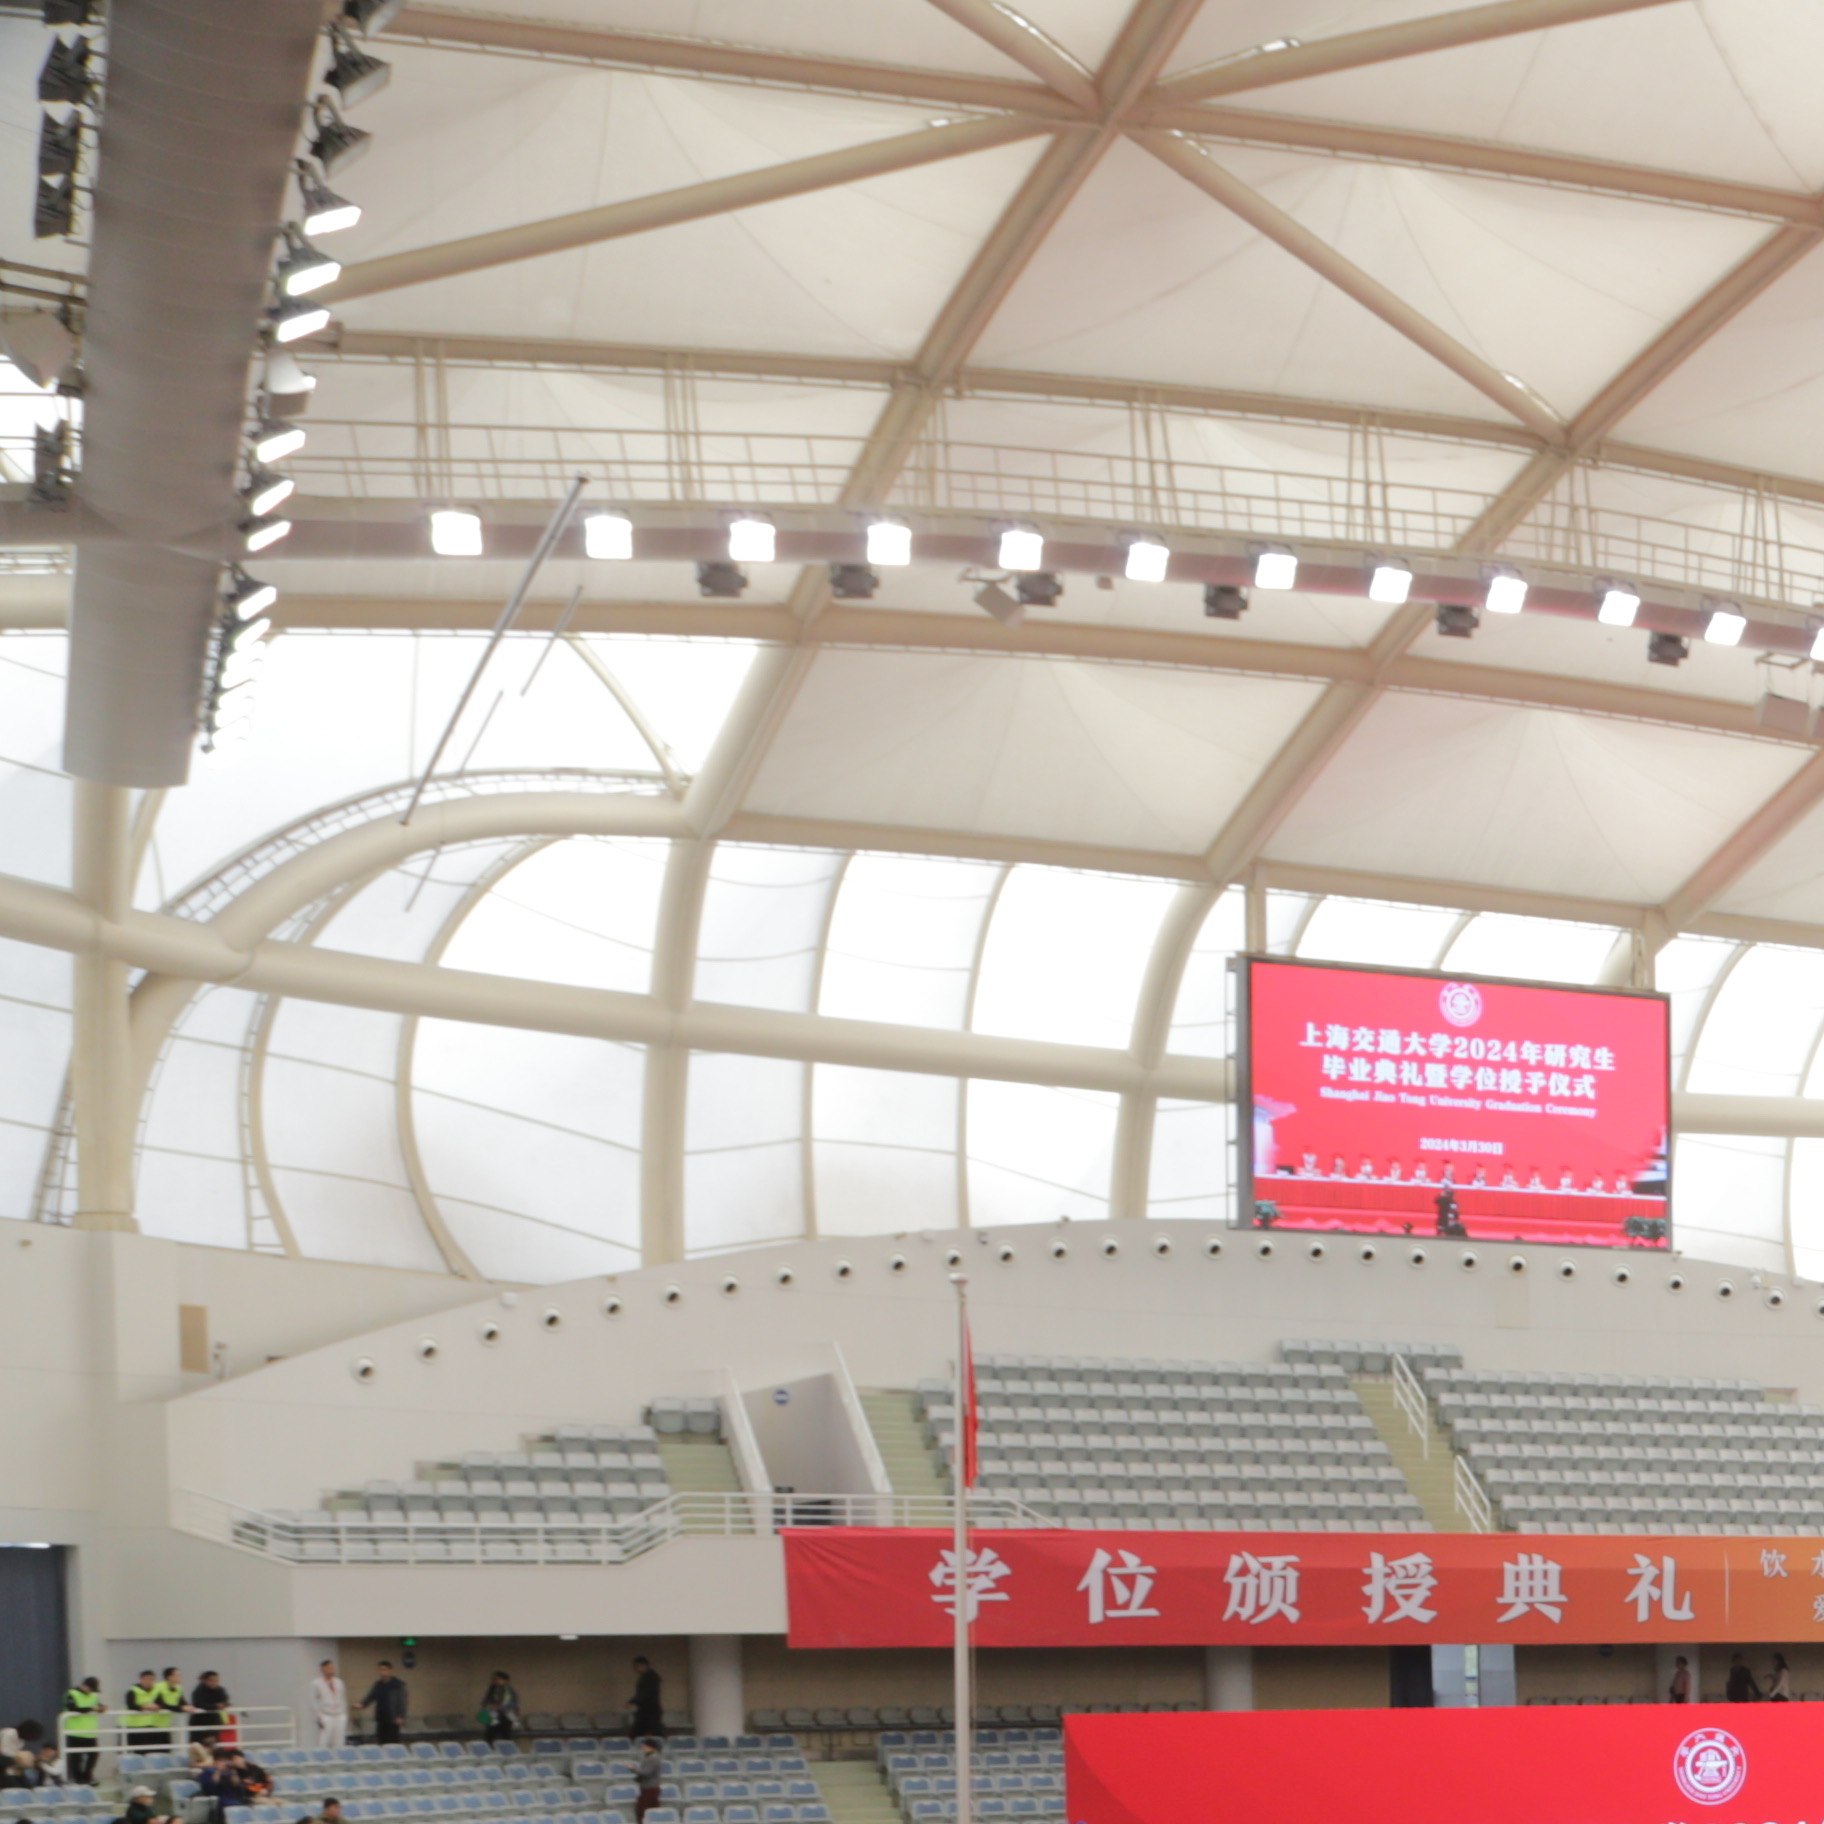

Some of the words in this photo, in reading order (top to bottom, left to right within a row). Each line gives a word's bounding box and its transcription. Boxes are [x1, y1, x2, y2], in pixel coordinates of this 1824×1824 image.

[1300, 1023, 1615, 1071] 上海交通大学2024年研究生
[1322, 1056, 1596, 1099] 毕业典礼暨学位授予仪式
[1320, 1086, 1370, 1102] Shanghai
[1373, 1089, 1395, 1103] Jiao
[1398, 1092, 1426, 1107] Tong
[1429, 1094, 1482, 1111] University
[1486, 1098, 1542, 1113] Graduation
[1545, 1103, 1596, 1118] Ceremony
[1420, 1138, 1504, 1156] 2024年3月30日
[929, 1546, 1697, 1626] 学位颁授典礼
